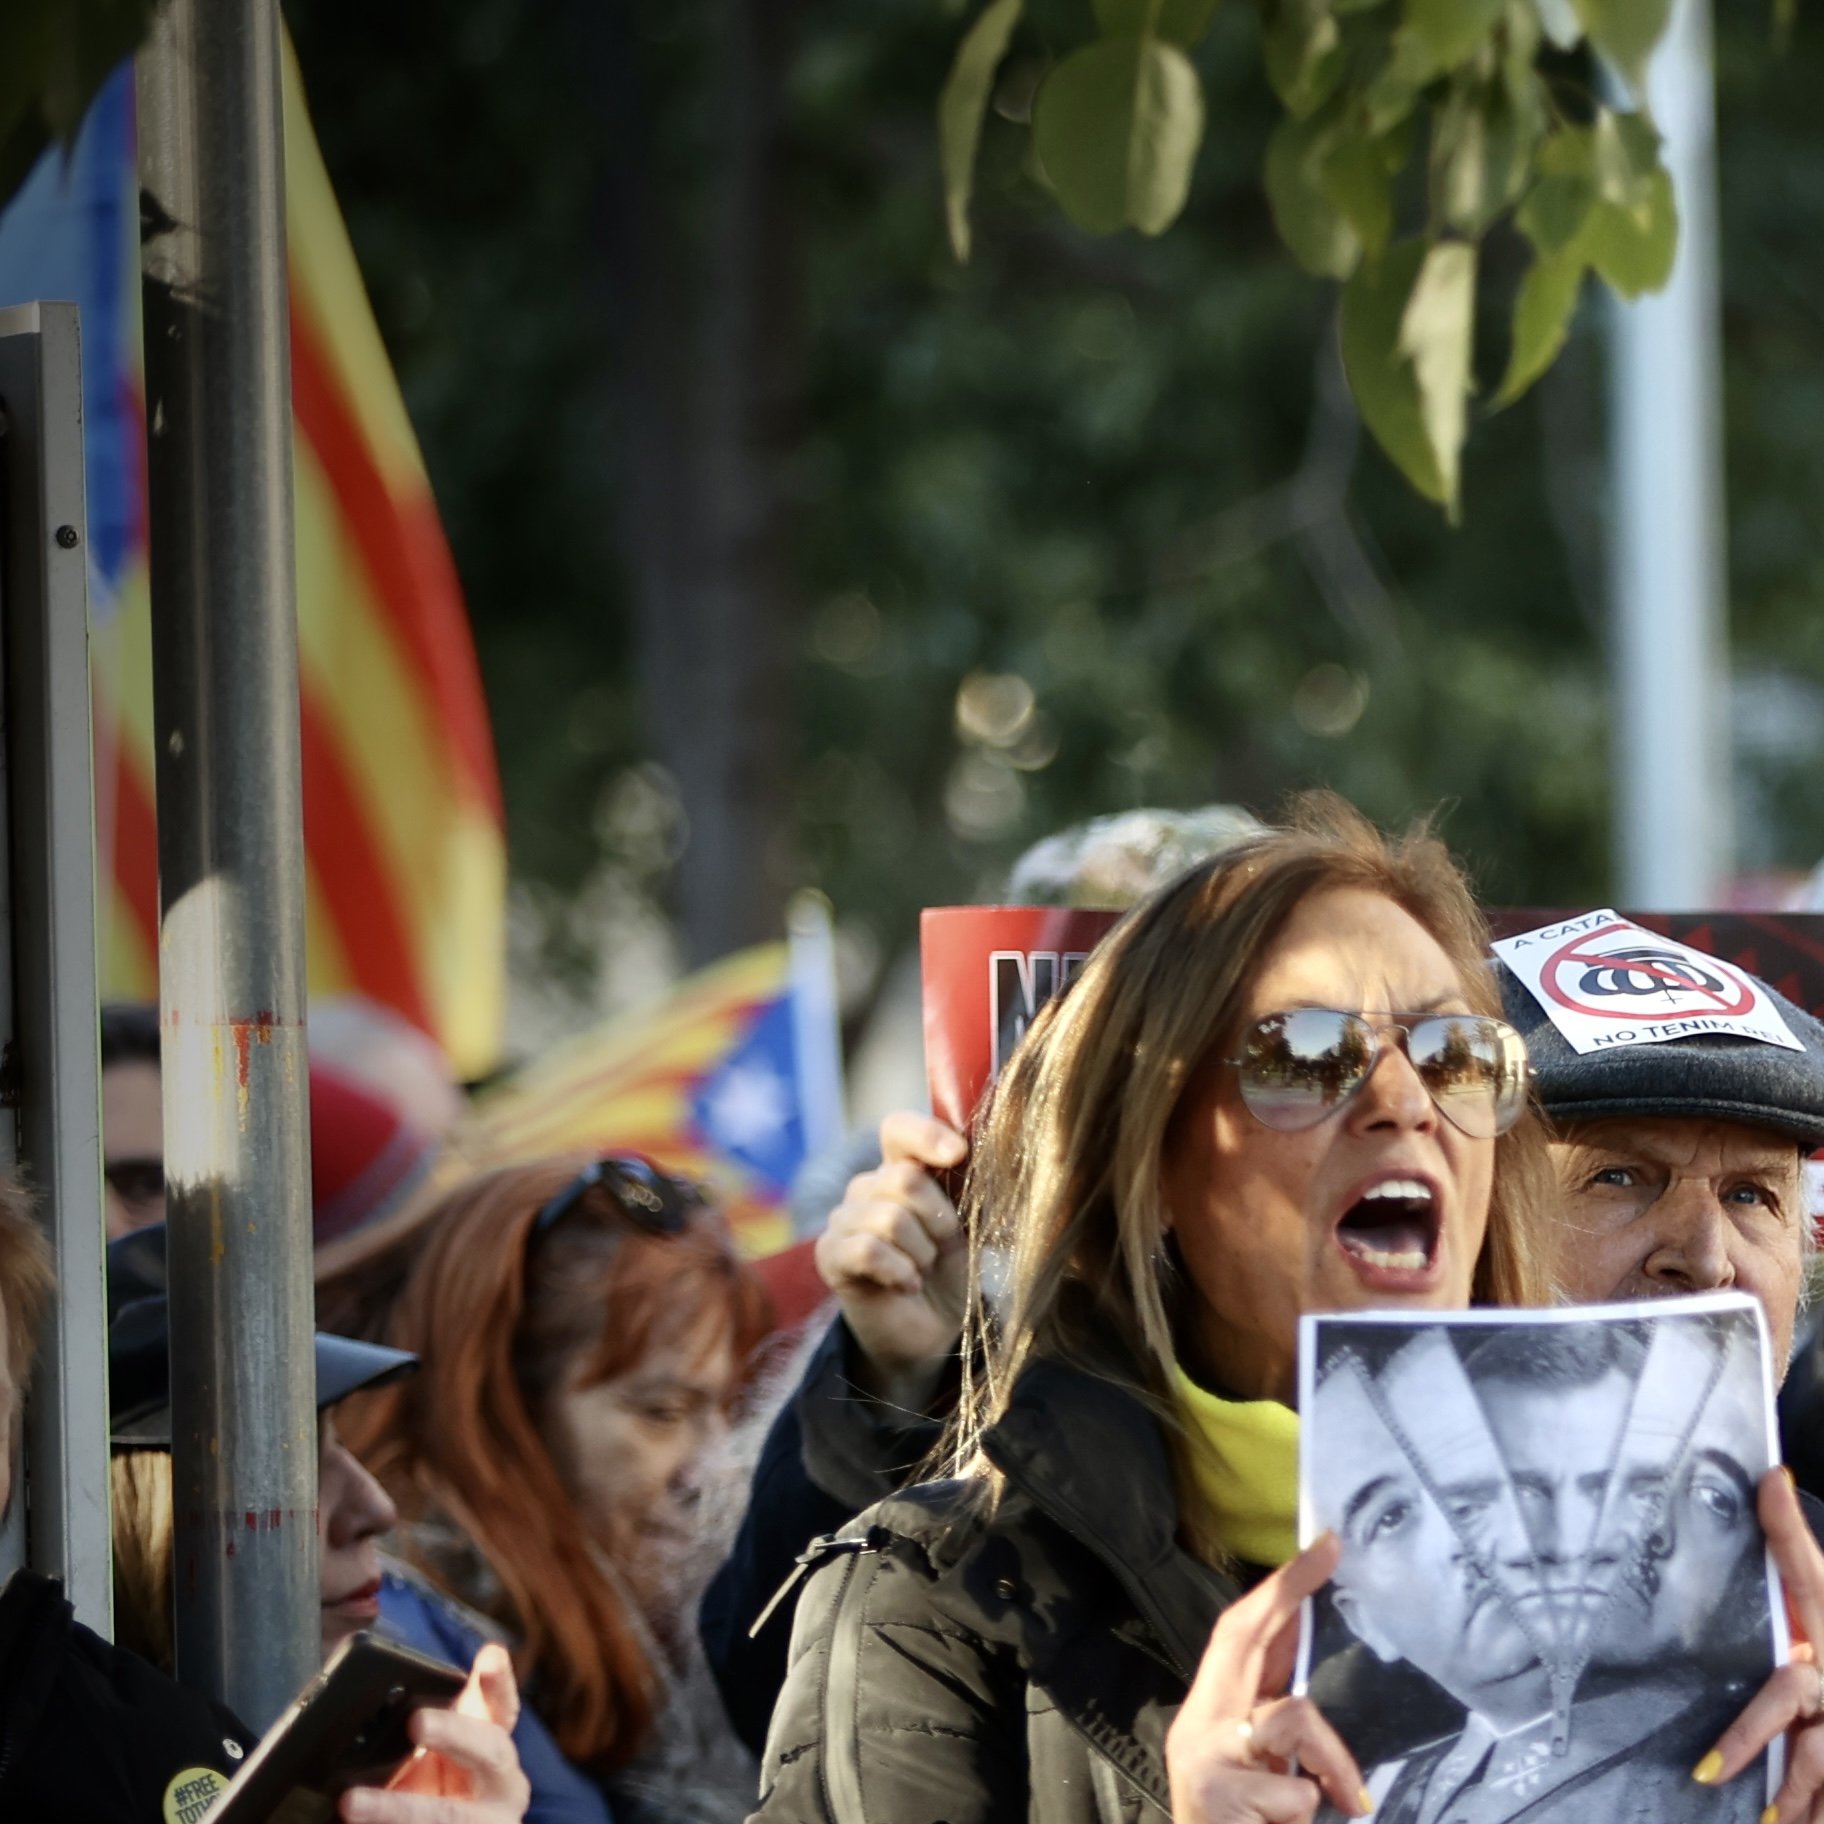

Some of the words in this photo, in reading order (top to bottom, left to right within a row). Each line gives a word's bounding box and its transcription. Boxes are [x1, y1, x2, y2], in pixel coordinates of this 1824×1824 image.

[989, 950, 1091, 1080] N
[1593, 1030, 1636, 1046] NO
[1642, 1020, 1732, 1038] TENIM
